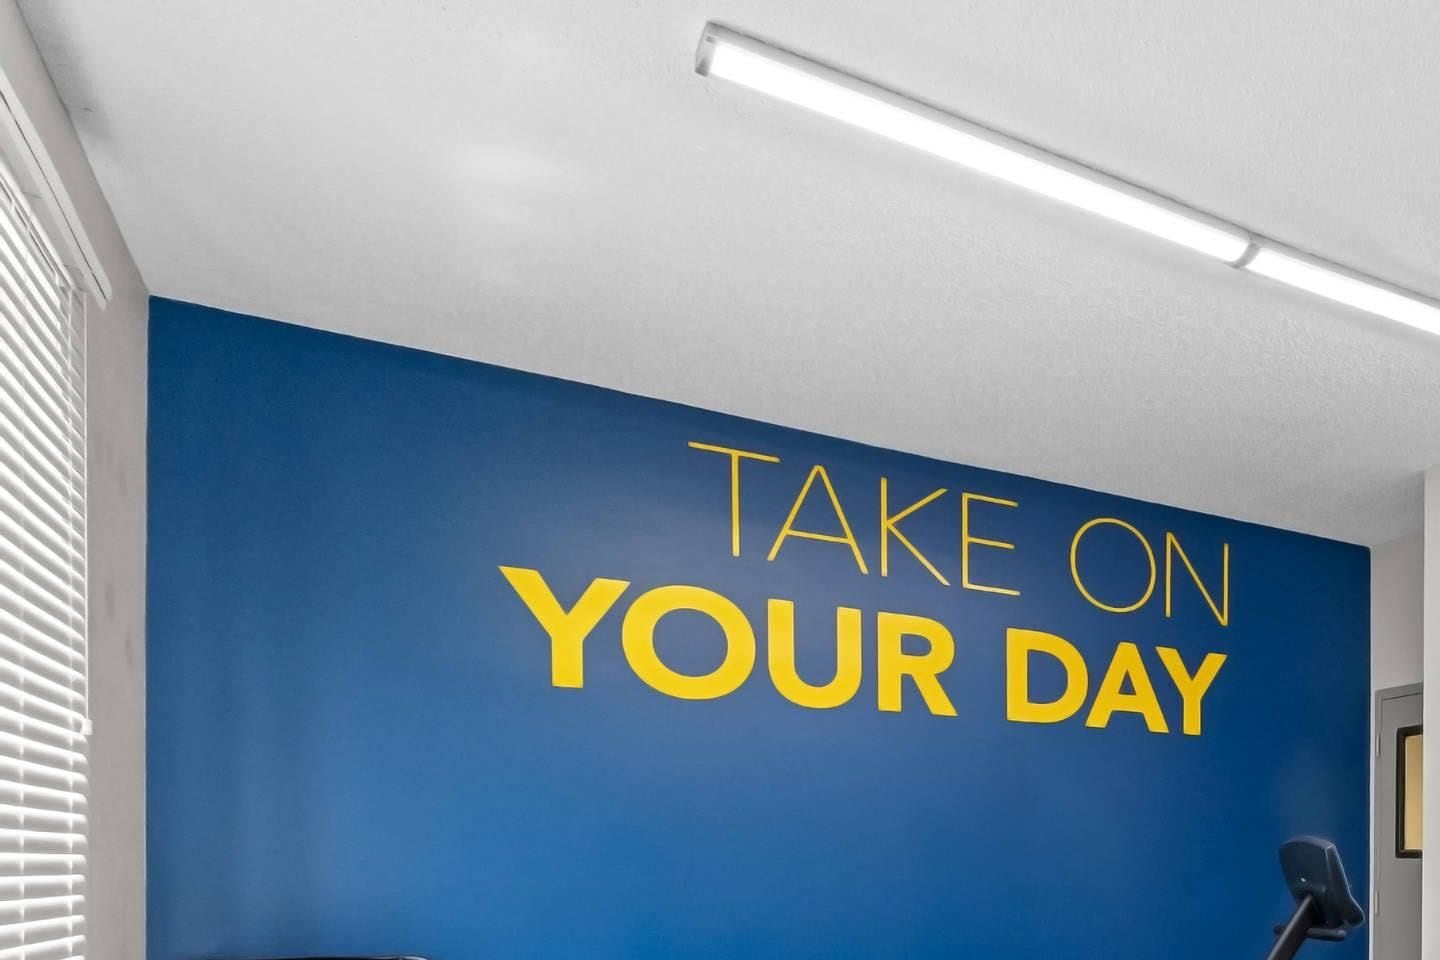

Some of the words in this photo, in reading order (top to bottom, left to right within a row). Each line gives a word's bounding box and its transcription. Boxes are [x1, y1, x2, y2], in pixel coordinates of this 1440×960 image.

[687, 441, 1021, 596] TAKE
[1069, 517, 1230, 626] ON
[498, 565, 959, 716] YOUR
[1005, 627, 1228, 735] DAY
